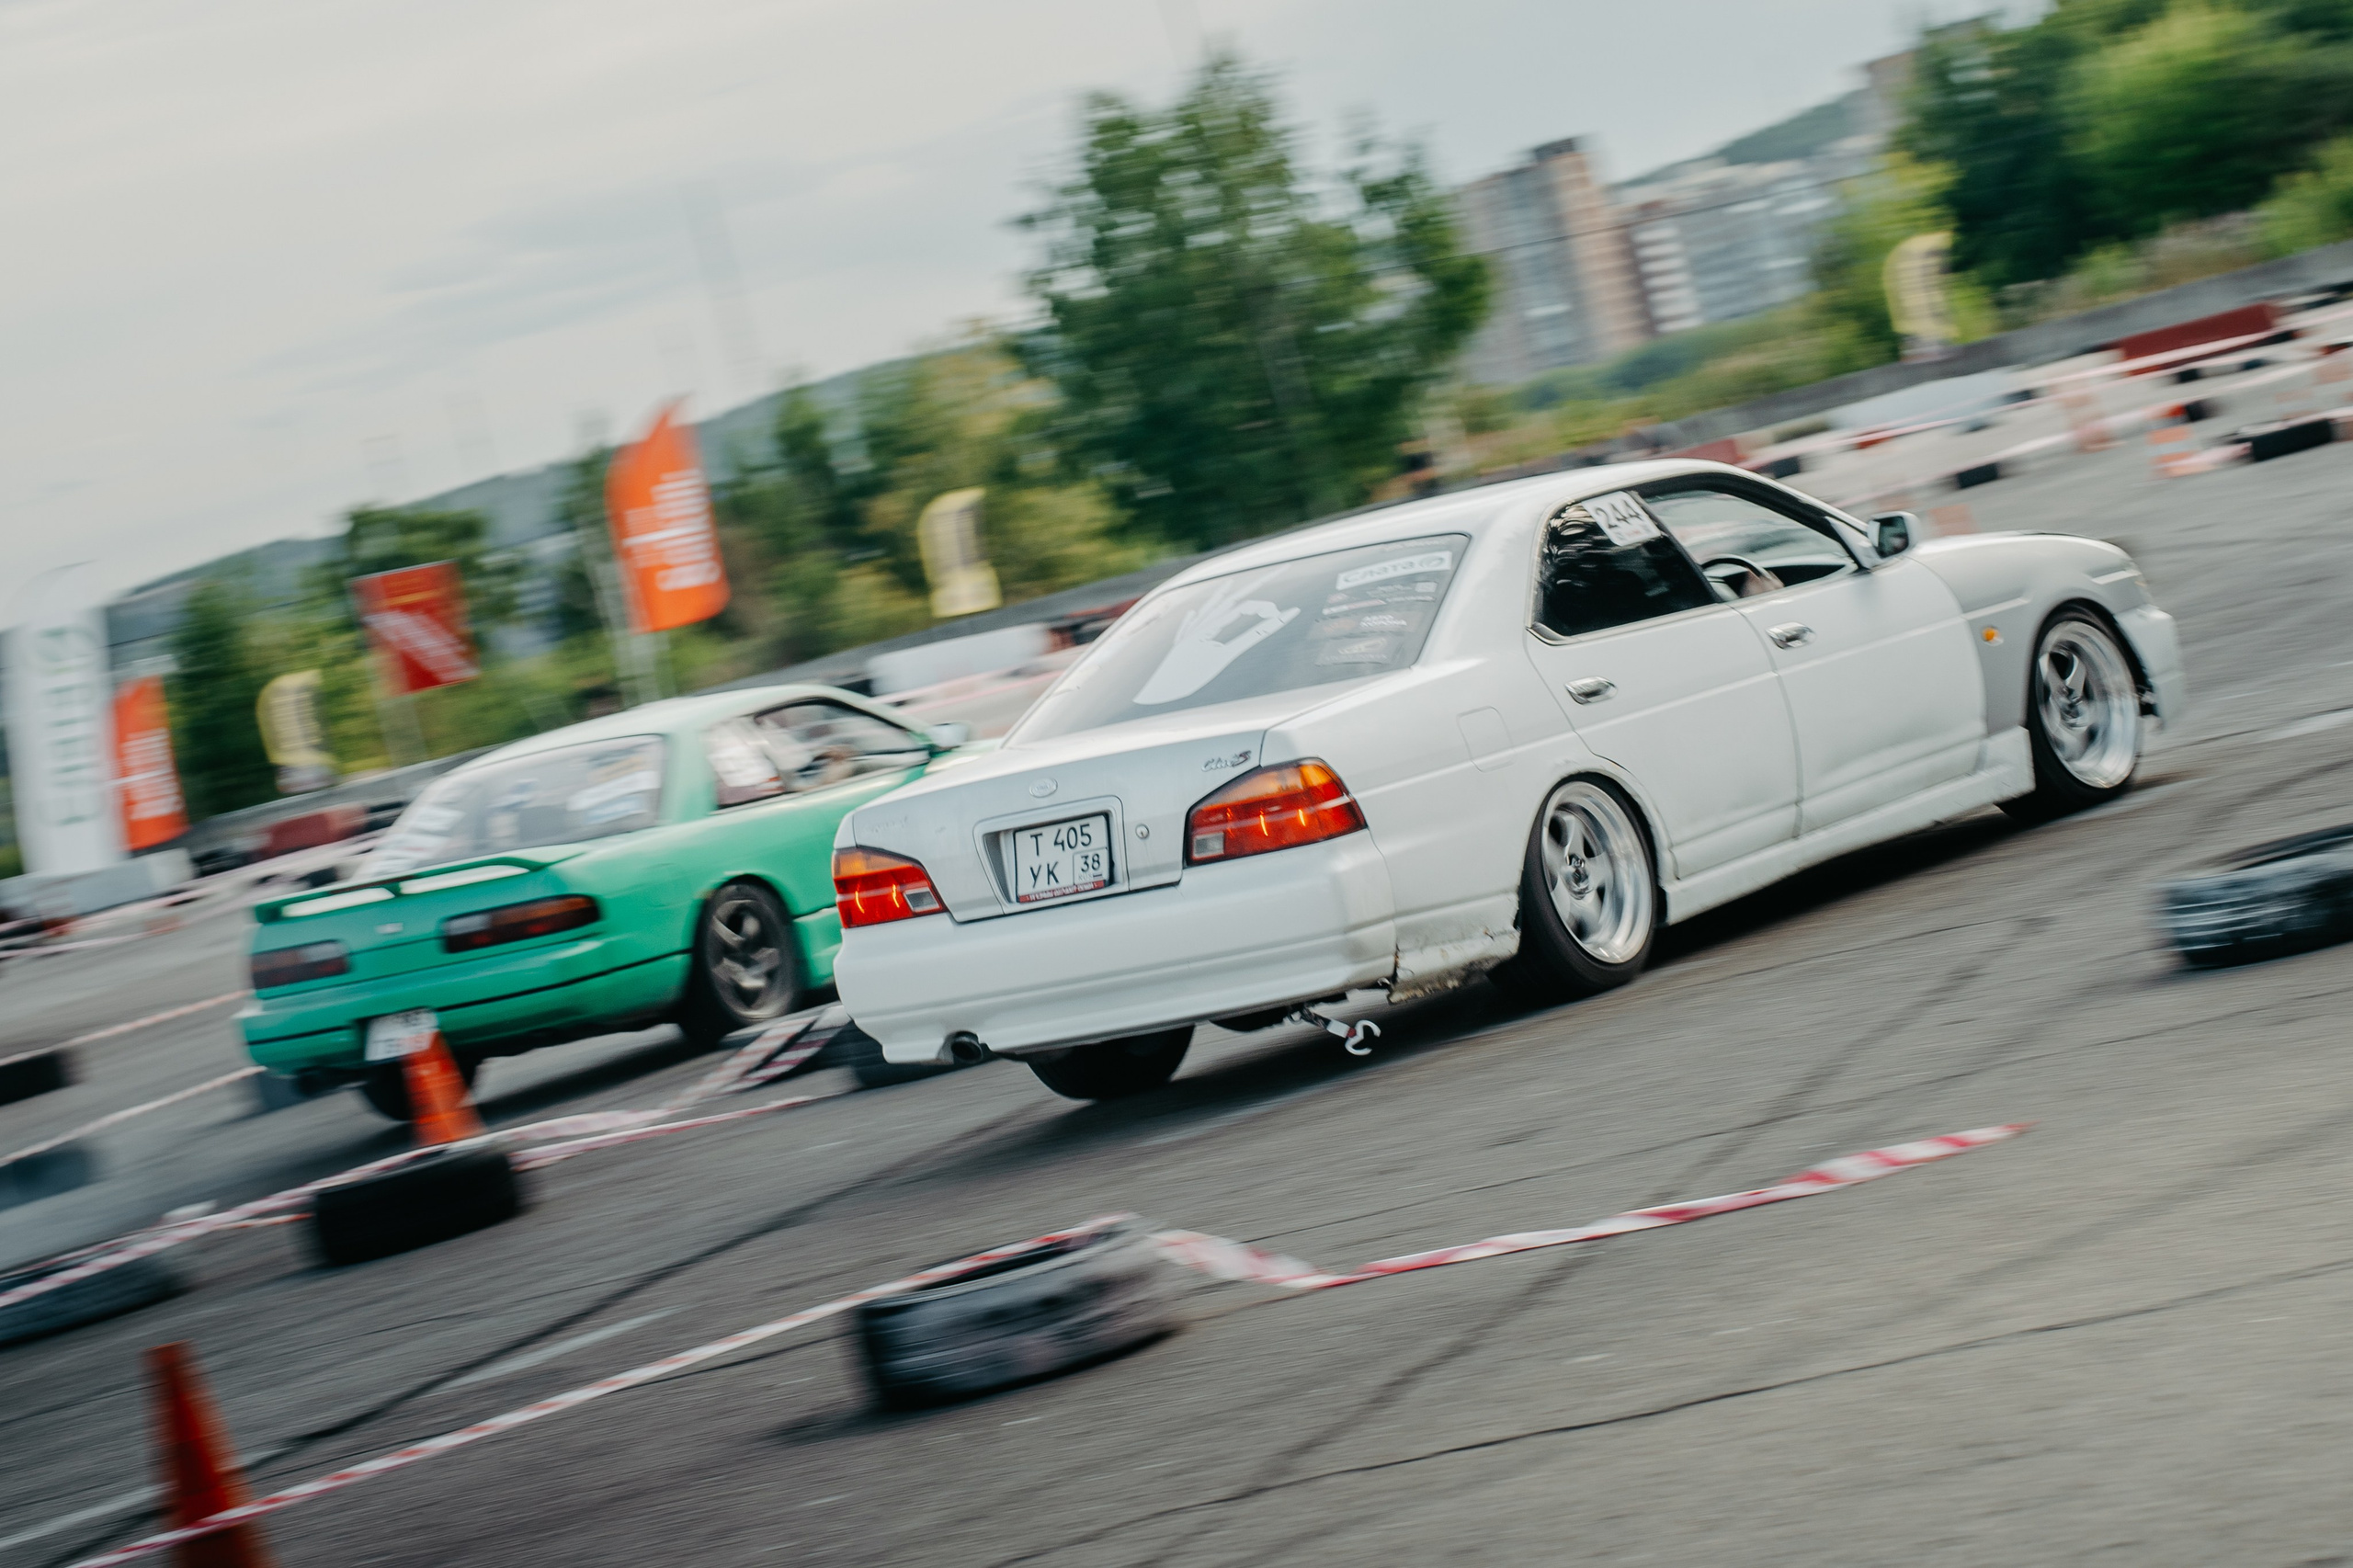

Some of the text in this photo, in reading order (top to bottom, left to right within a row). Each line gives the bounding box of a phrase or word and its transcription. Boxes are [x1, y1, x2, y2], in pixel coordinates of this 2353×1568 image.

[1596, 499, 1644, 529] 244
[1053, 824, 1092, 851] 405
[1080, 853, 1101, 873] 38
